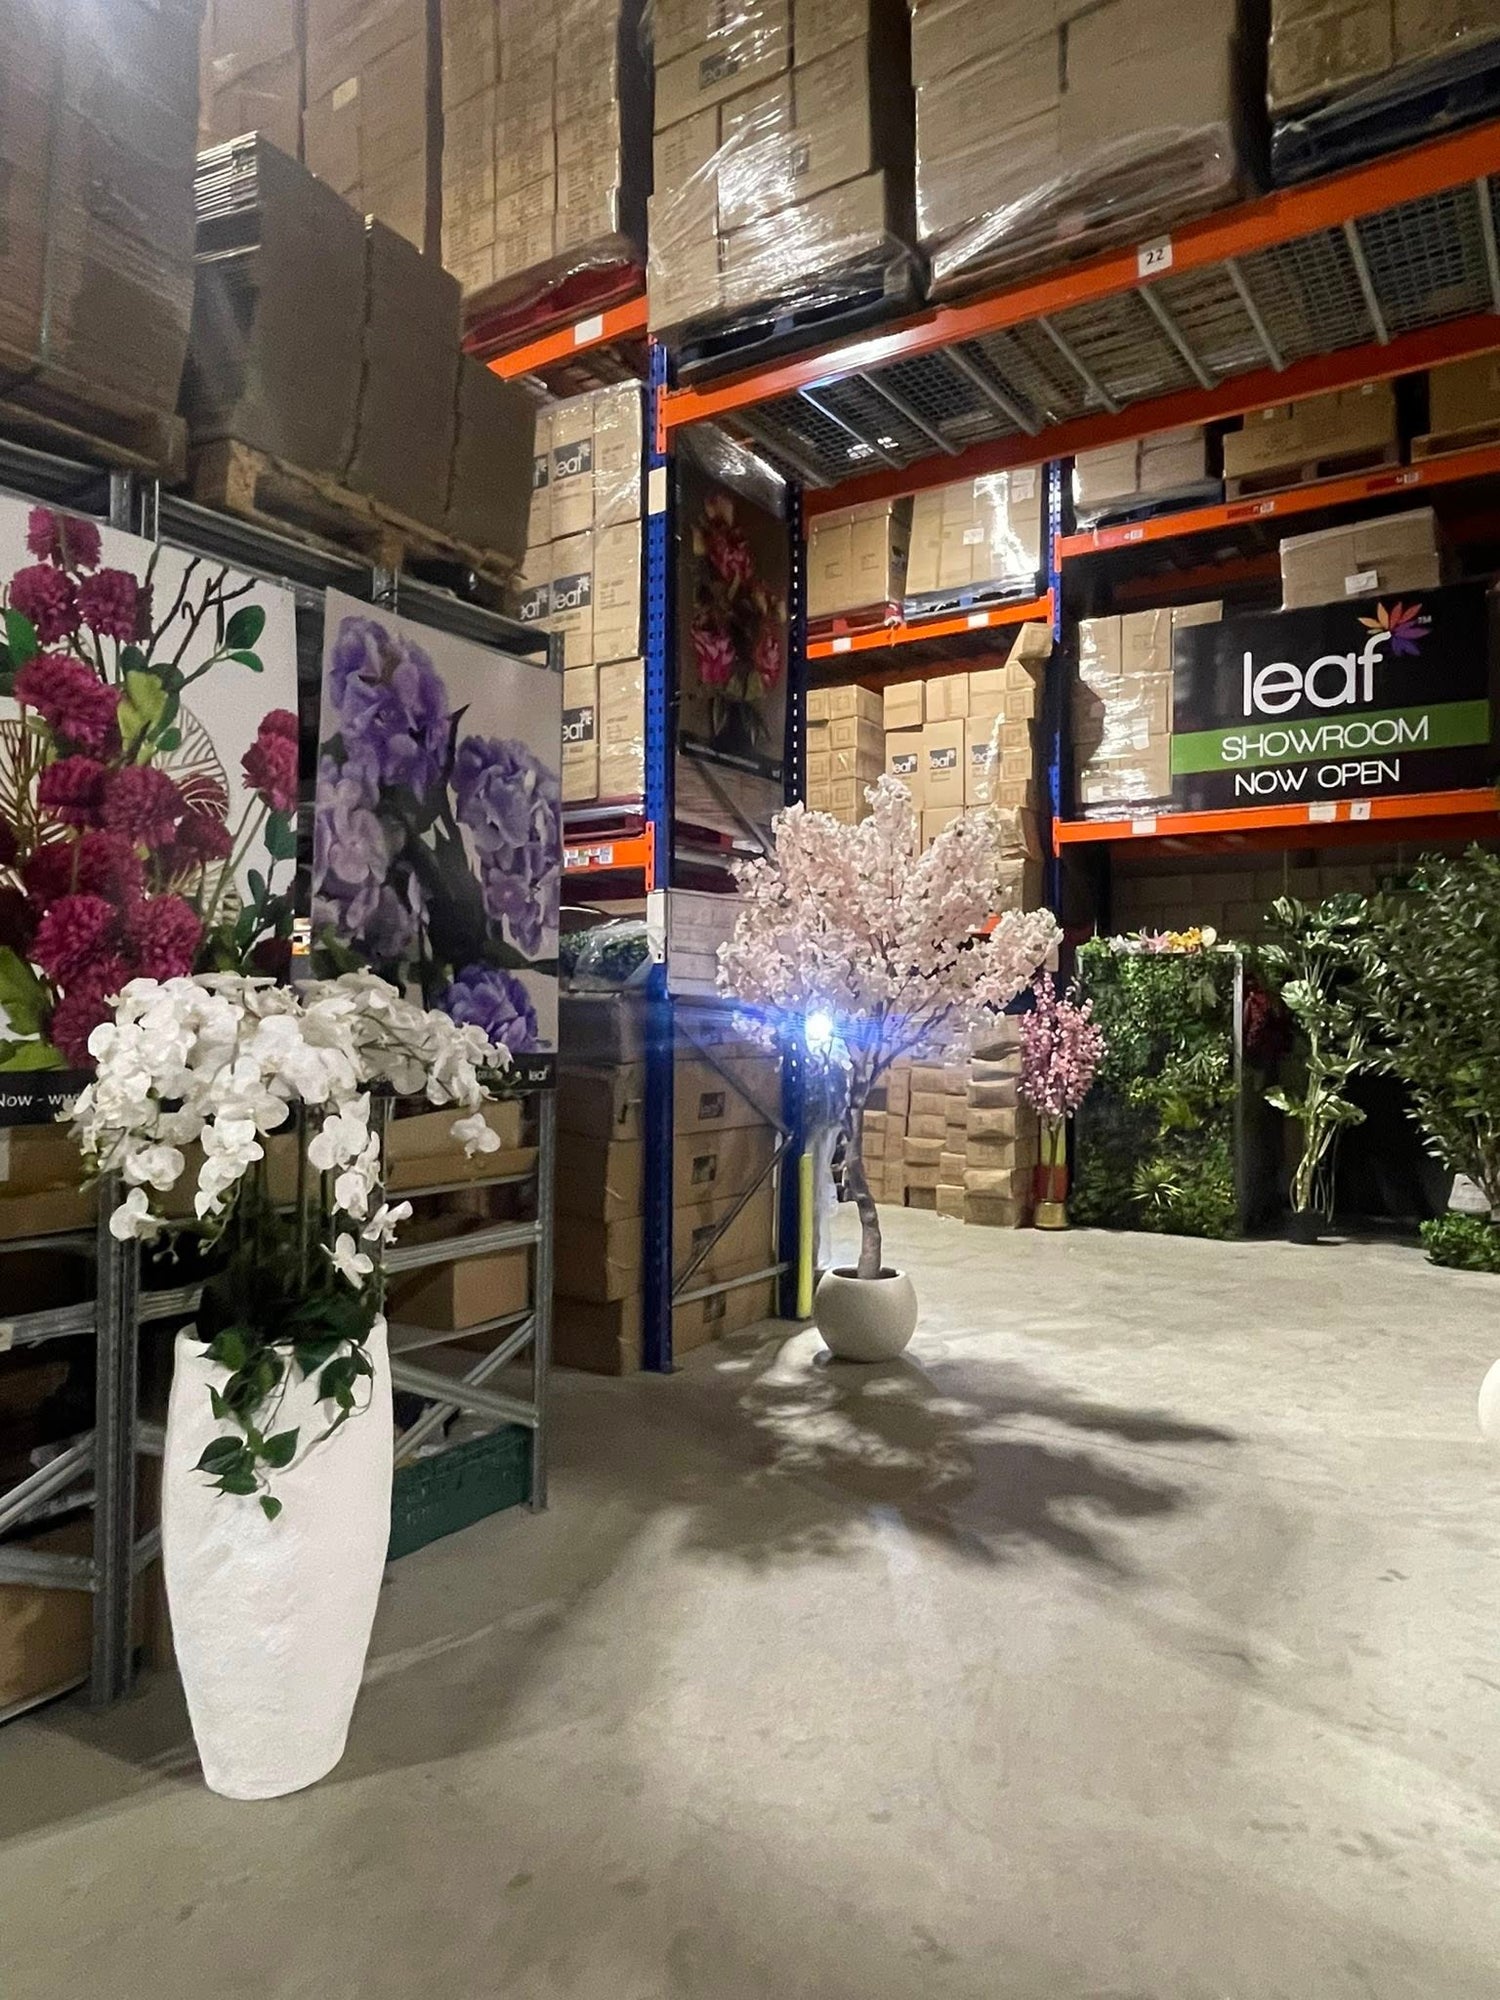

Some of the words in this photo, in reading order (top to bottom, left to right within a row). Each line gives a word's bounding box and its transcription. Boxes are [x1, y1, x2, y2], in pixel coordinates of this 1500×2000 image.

[1146, 248, 1164, 265] 22
[1243, 631, 1392, 717] leaf
[1221, 715, 1429, 762] SHOWROOM
[1234, 767, 1306, 796] NOW
[1318, 759, 1400, 790] OPEN
